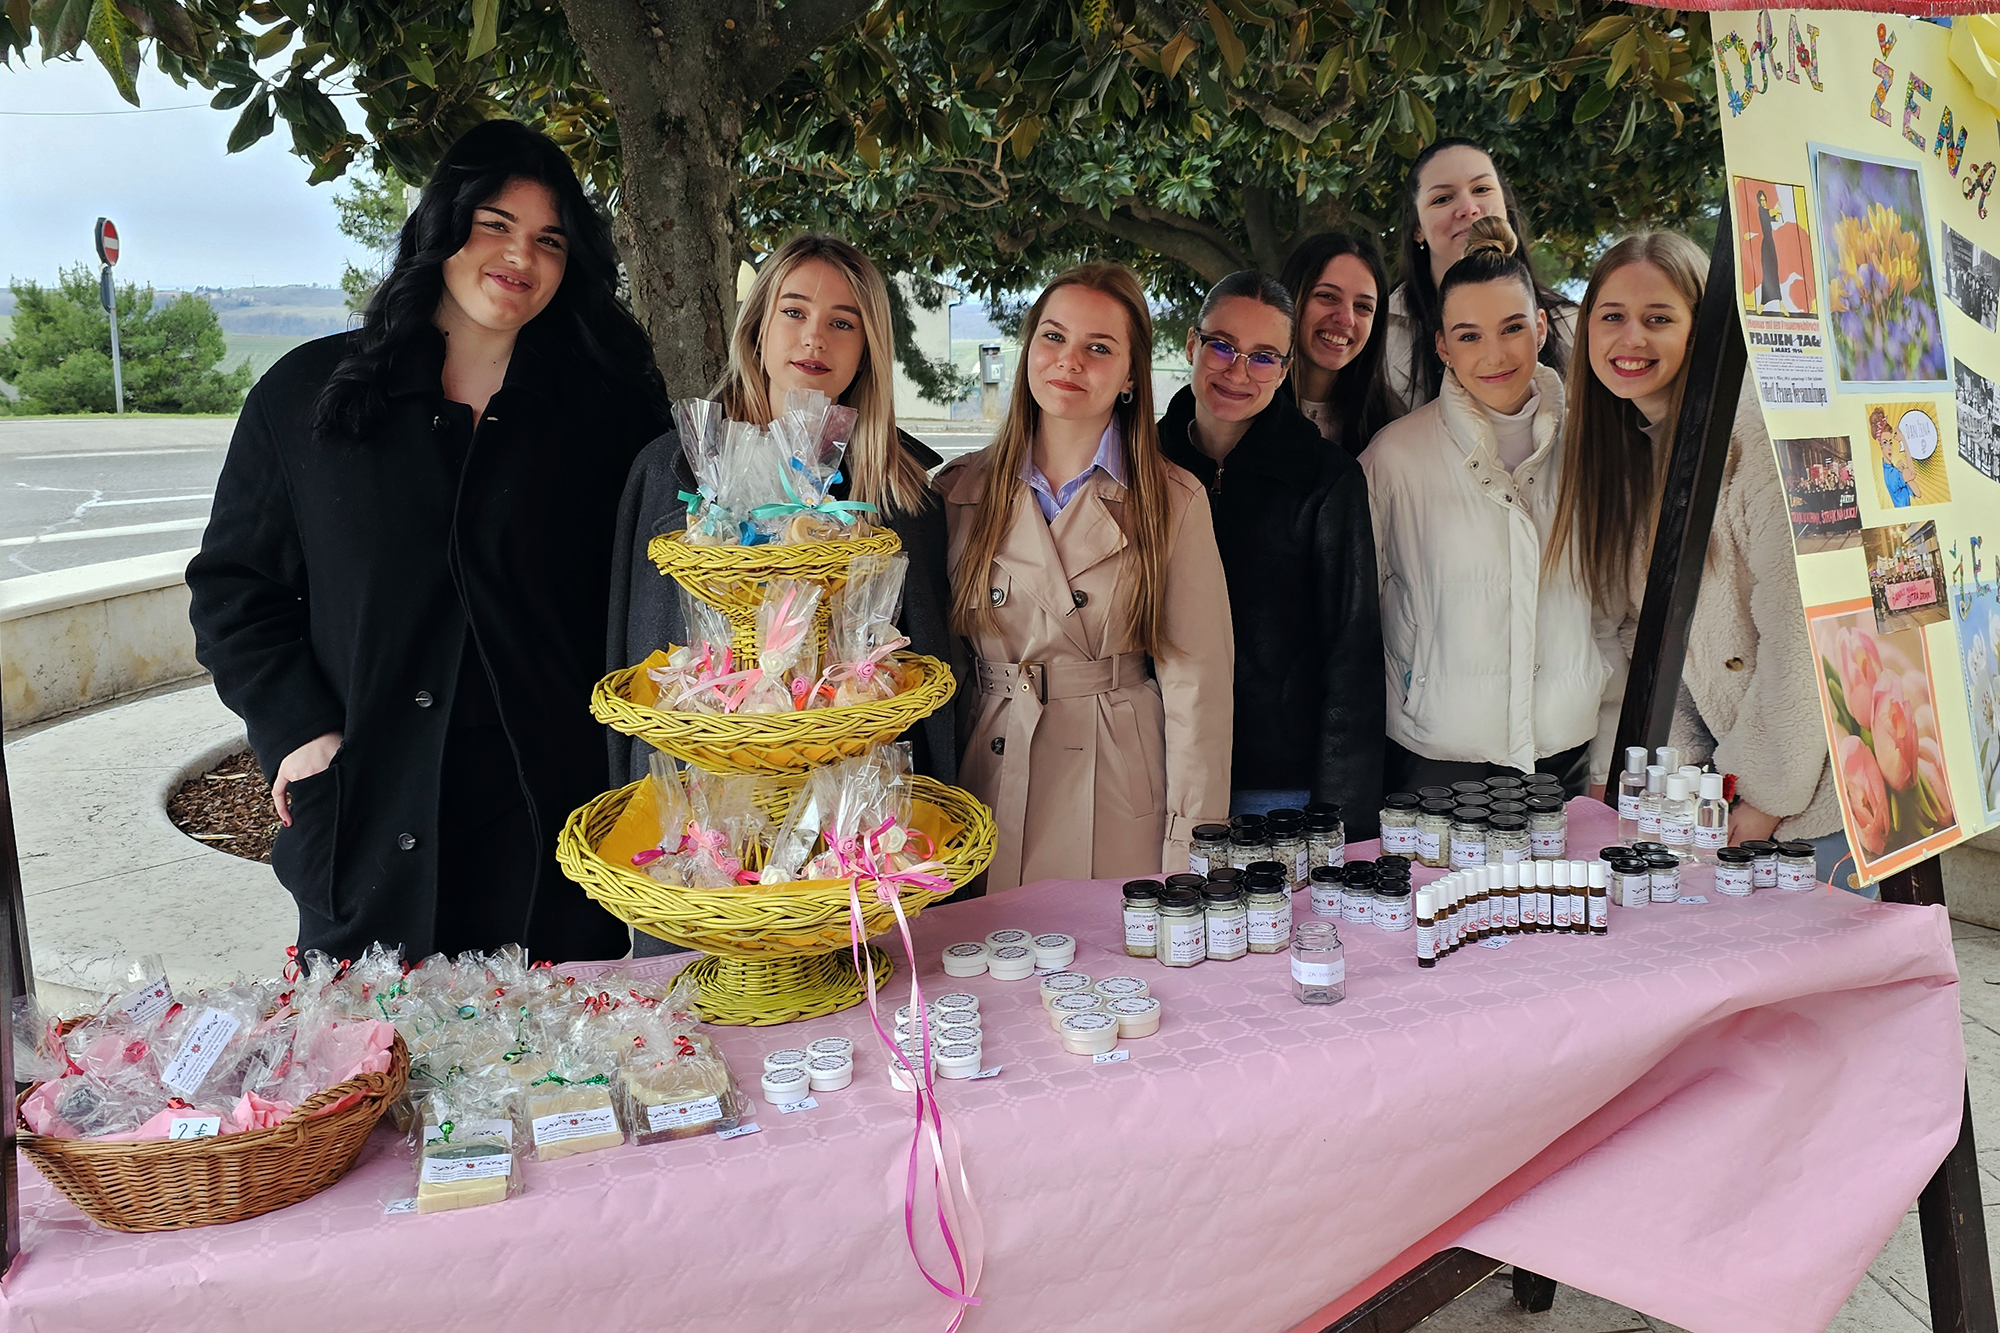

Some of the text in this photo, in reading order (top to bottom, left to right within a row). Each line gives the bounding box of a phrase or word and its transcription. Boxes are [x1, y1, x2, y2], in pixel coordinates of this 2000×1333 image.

[1714, 9, 1997, 220] DAN ŽENA
[1949, 535, 2000, 621] ŽE
